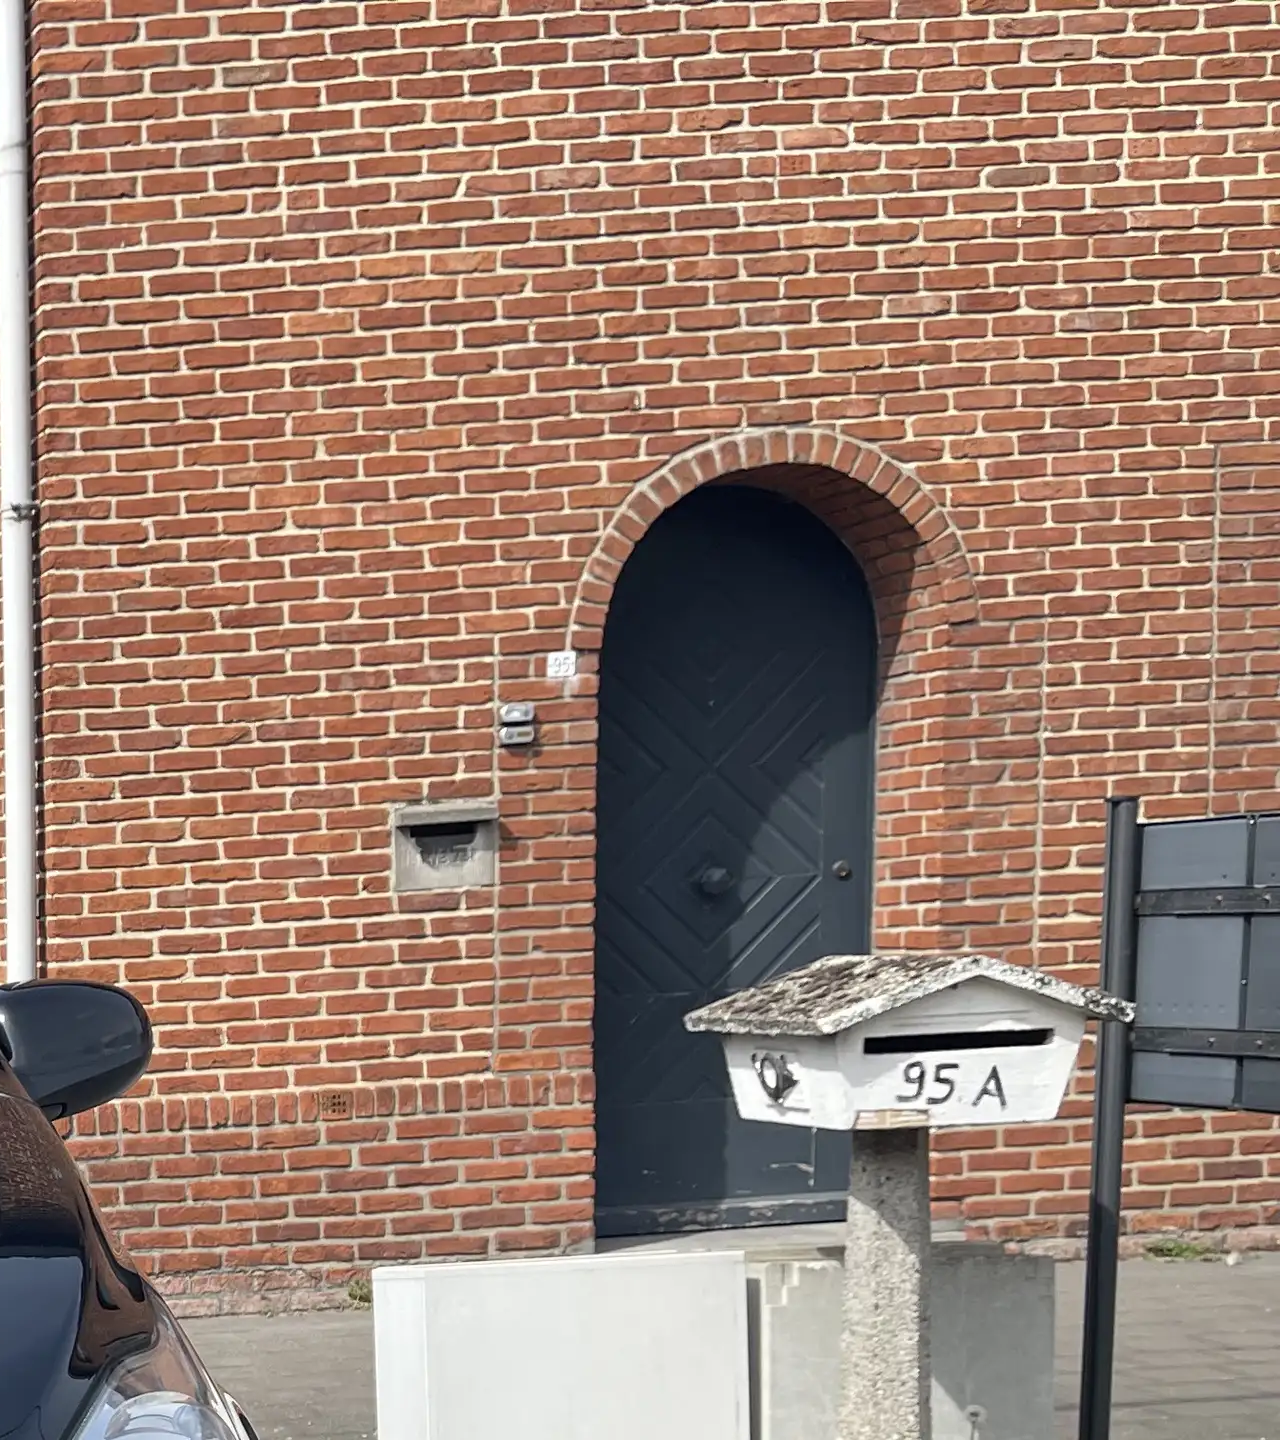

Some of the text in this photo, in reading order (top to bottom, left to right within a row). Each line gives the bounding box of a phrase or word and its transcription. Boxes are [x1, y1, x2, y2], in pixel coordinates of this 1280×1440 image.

[553, 656, 570, 674] 95
[895, 1060, 1007, 1111] 95 A
